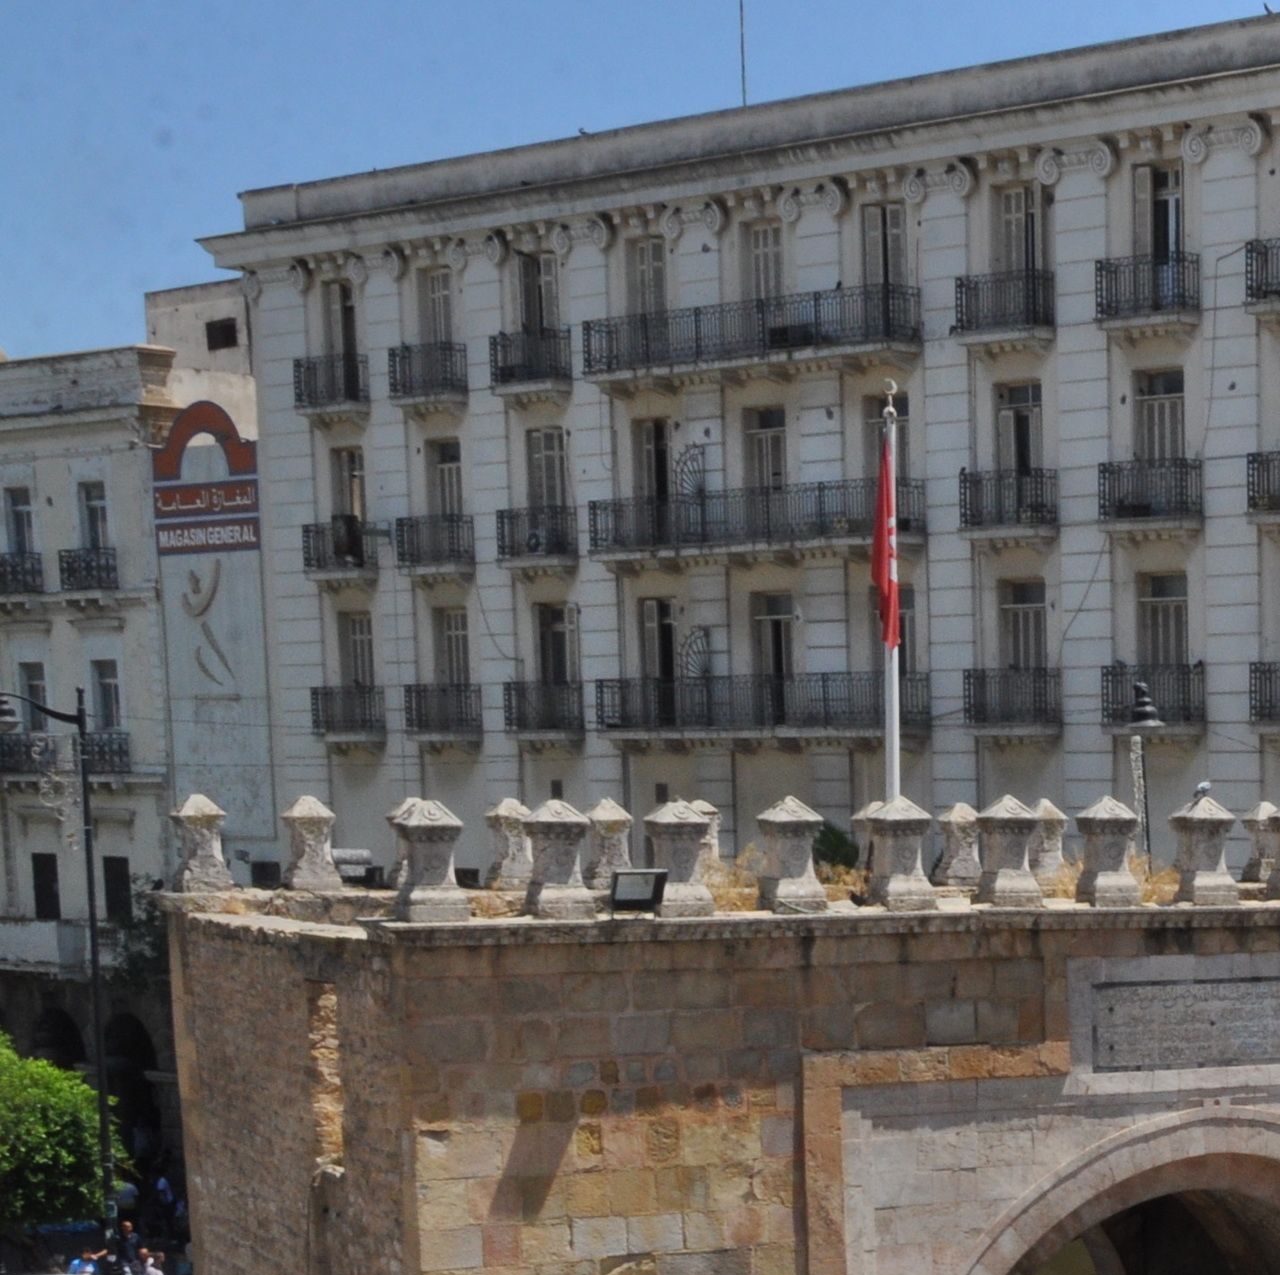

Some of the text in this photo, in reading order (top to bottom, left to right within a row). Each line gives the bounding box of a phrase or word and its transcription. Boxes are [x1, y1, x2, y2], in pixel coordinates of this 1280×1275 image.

[155, 486, 256, 511] المغازة العامة
[158, 524, 257, 548] MAGASIN GENERAL
